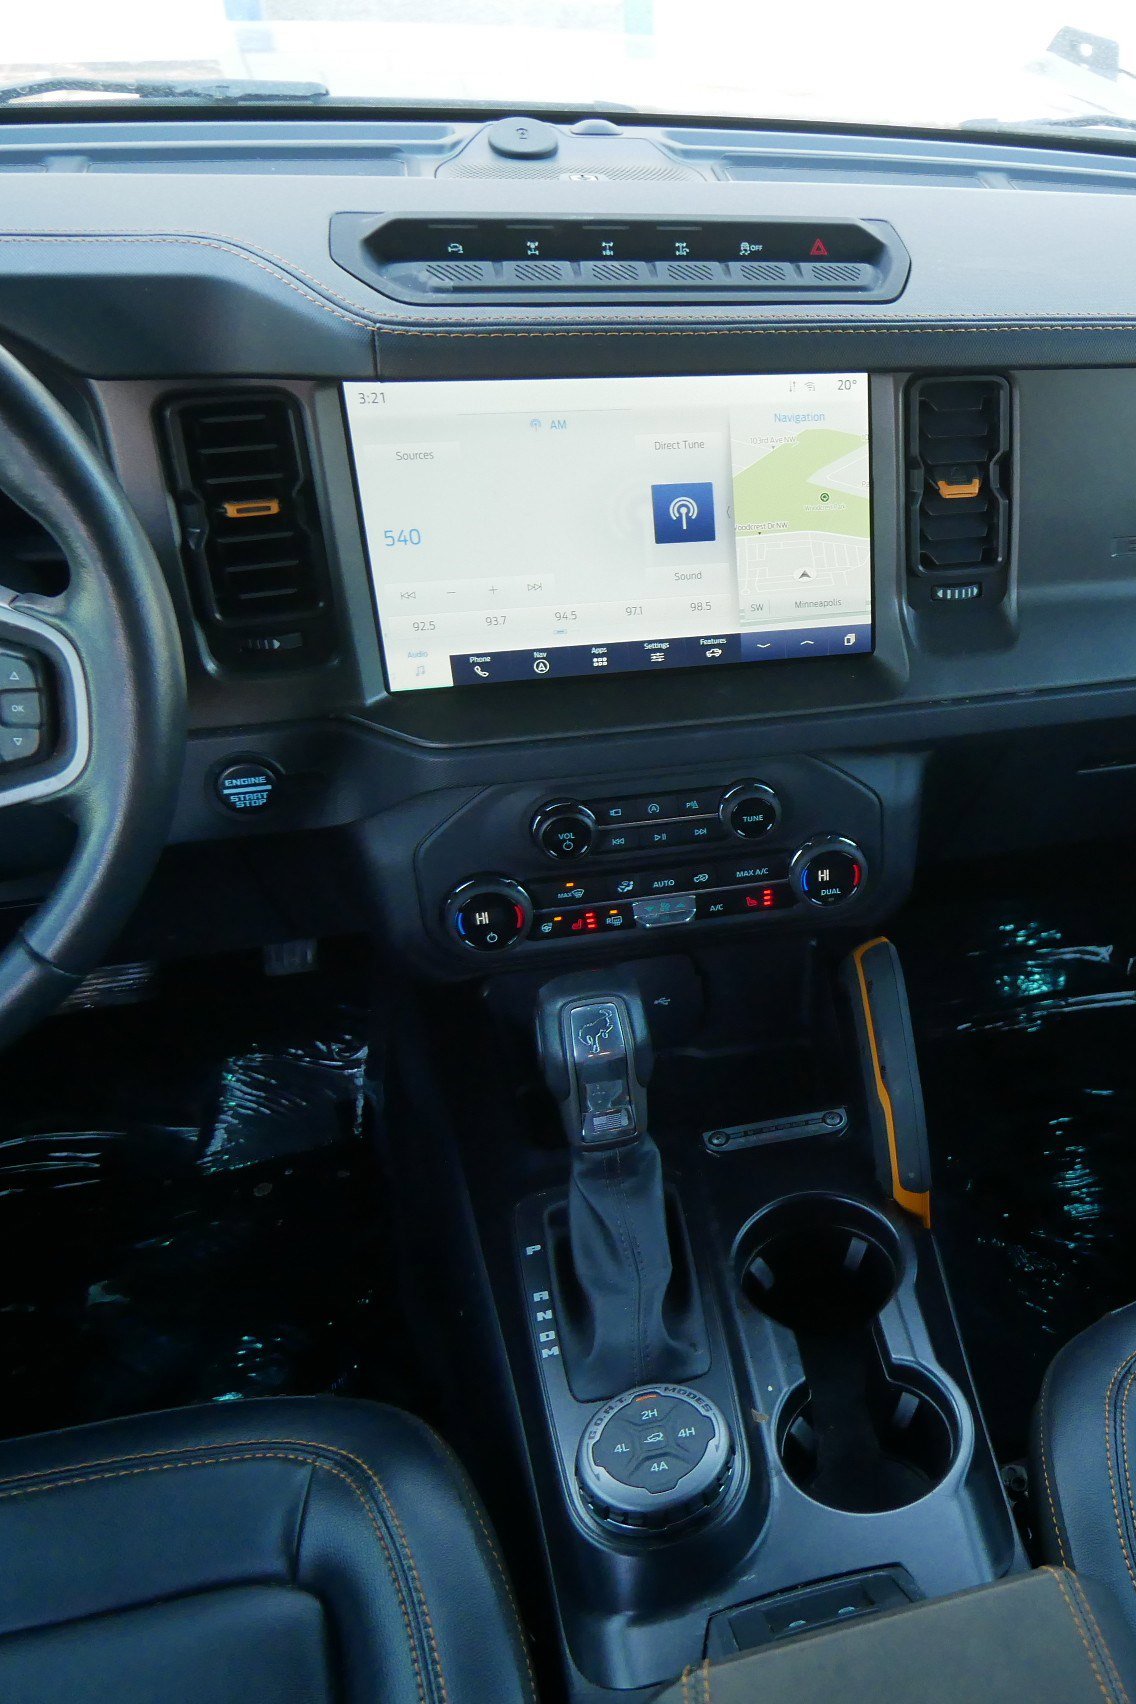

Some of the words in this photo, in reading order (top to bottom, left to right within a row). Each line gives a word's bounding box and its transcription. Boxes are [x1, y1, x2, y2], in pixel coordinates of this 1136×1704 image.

[357, 391, 387, 405] 3:21
[773, 411, 826, 423] Navigation
[549, 419, 568, 431] AM
[654, 440, 681, 451] Direct
[682, 439, 705, 450] Tune
[395, 450, 434, 461] Sources
[384, 528, 421, 547] 540
[674, 571, 702, 582] Sound
[750, 603, 764, 612] SW
[794, 598, 842, 609] Minneapolis
[412, 621, 436, 632] 92.5
[485, 616, 507, 626] 93.7
[555, 610, 578, 621] 94.5
[625, 606, 643, 617] 97.1
[690, 602, 712, 612] 98.5
[407, 650, 429, 659] Audio
[469, 655, 491, 663] Phone
[591, 646, 608, 655] Apps
[643, 641, 670, 650] Settings
[699, 637, 727, 645] Features
[11, 704, 24, 712] OK
[224, 775, 267, 787] ENGINE
[230, 792, 269, 802] START
[236, 799, 267, 808] STOP
[742, 814, 764, 823] TUNE
[558, 832, 575, 840] VOL
[653, 879, 675, 888] AUTO
[736, 870, 754, 878] MAX
[754, 867, 769, 876] A/C
[817, 869, 830, 882] HI
[820, 887, 841, 896] DUAL
[709, 903, 724, 912] A/C
[475, 911, 490, 925] HI
[526, 1244, 541, 1255] P
[536, 1309, 553, 1321] N
[541, 1346, 560, 1358] M
[663, 1386, 713, 1413] MODES
[640, 1408, 658, 1420] 2H
[677, 1427, 696, 1438] 4H
[614, 1443, 630, 1453] 4L
[650, 1461, 669, 1472] 4A
